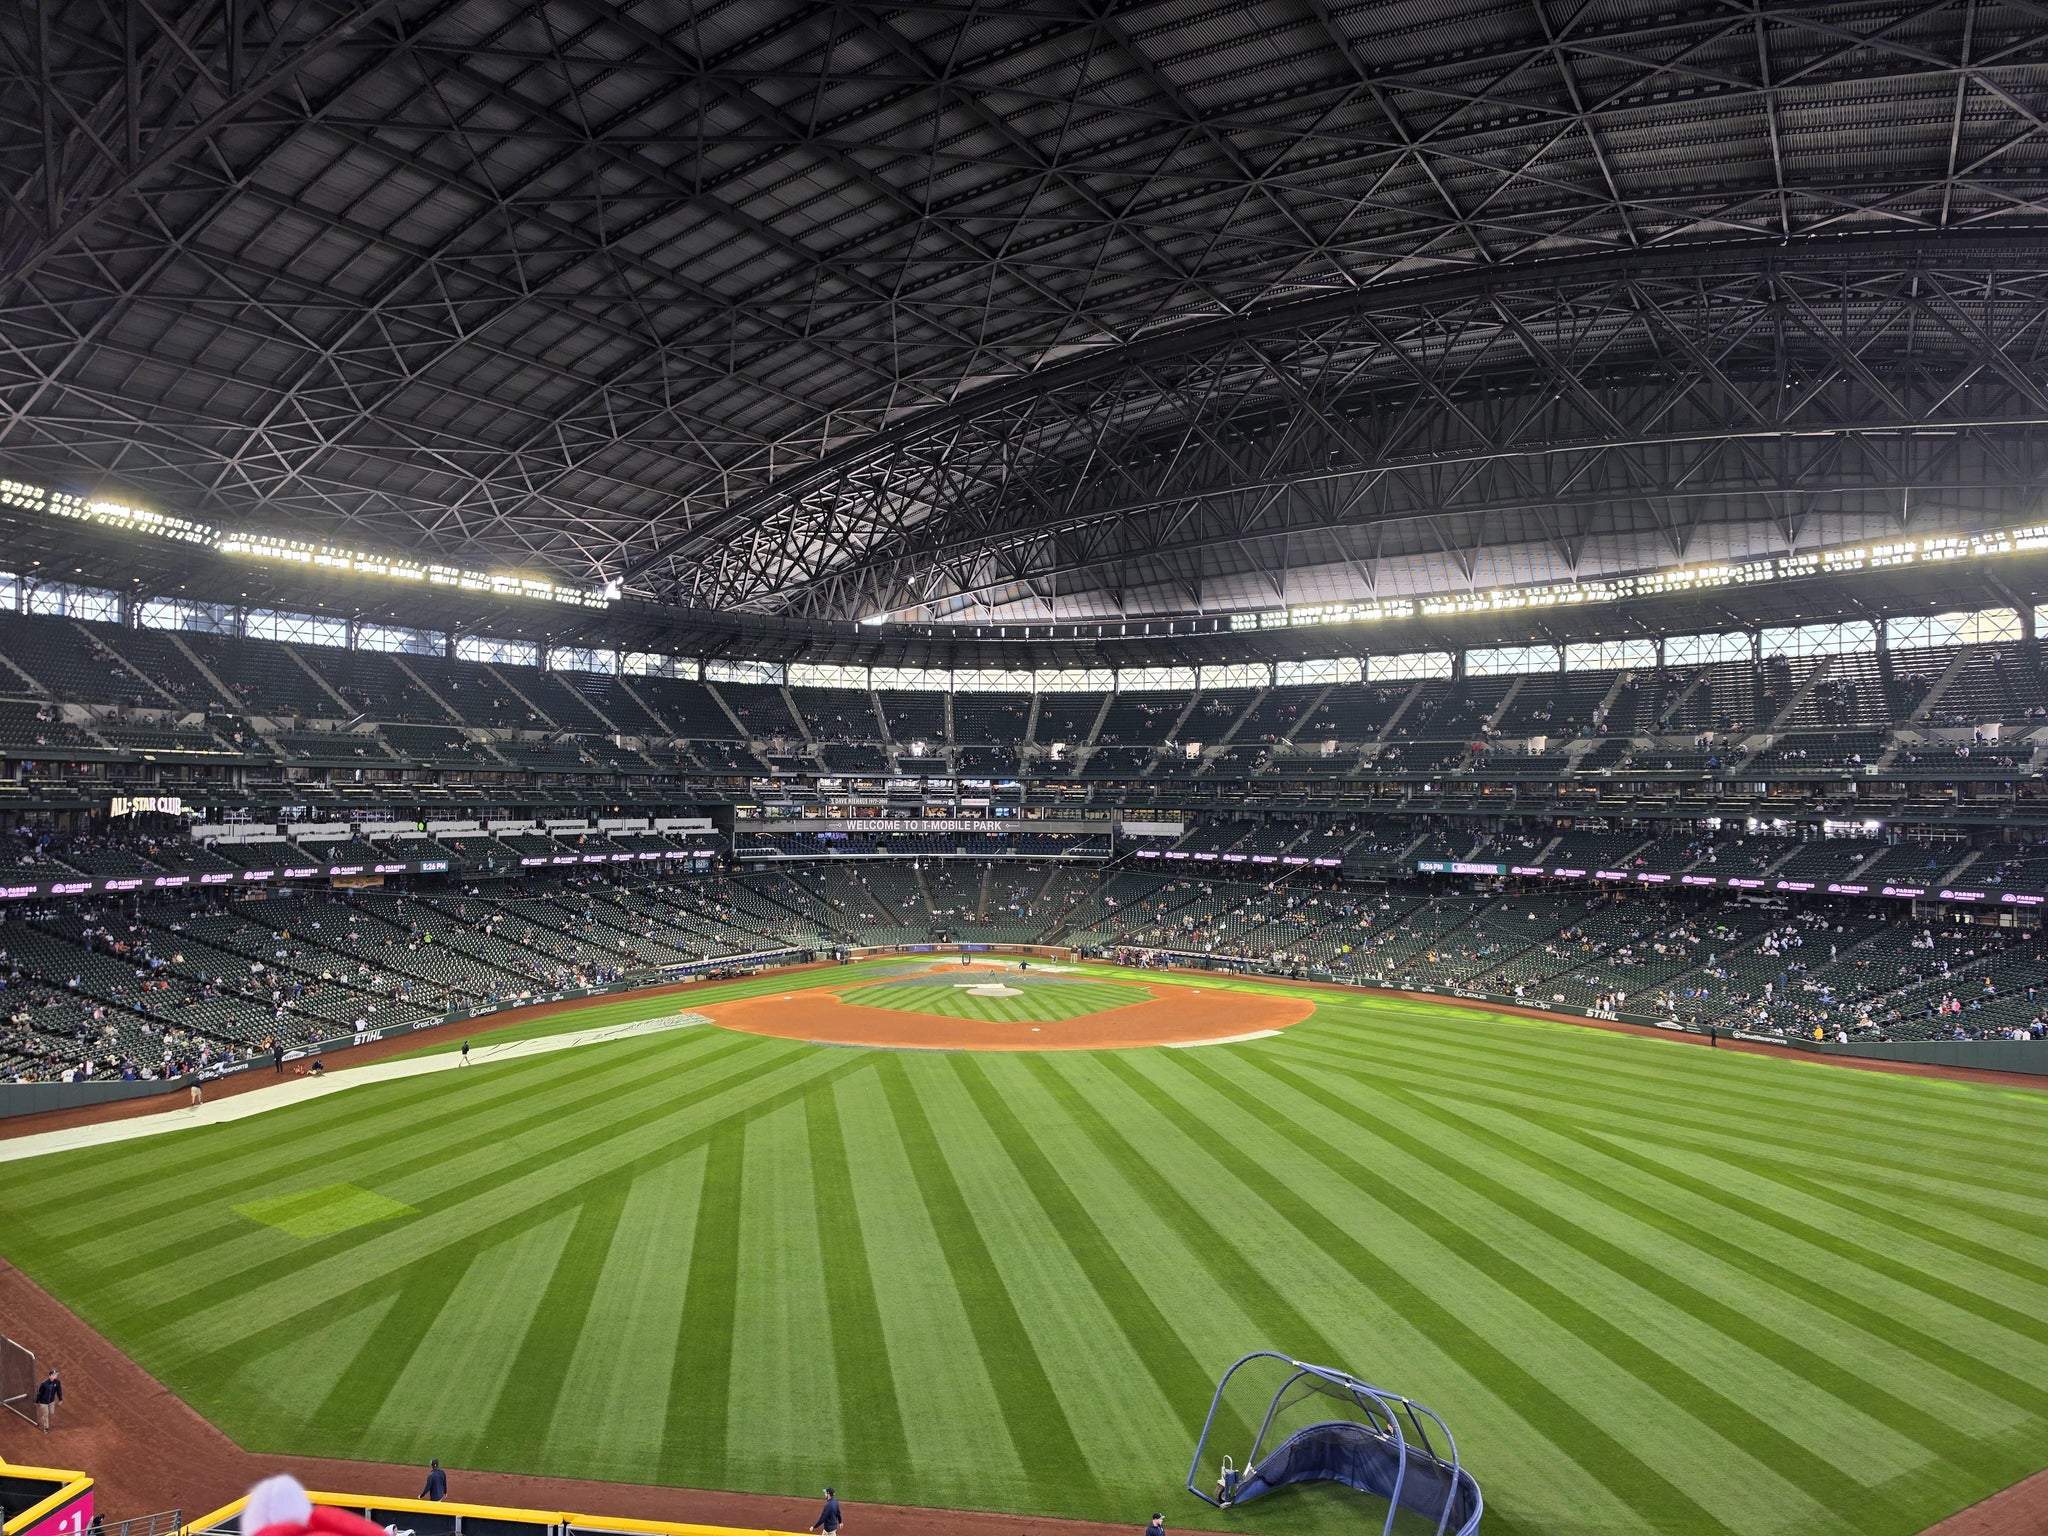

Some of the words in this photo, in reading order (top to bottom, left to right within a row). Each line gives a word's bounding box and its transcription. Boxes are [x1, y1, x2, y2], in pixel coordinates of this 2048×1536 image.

[157, 797, 181, 815] CLUB
[847, 820, 900, 830] WELCOME
[904, 820, 919, 830] TO
[922, 820, 971, 830] T-MOBILE
[973, 820, 1002, 830] PARK
[1466, 864, 1498, 874] BALLPARK
[1463, 992, 1487, 1000] LEXUS
[477, 1005, 497, 1015] LEXUS
[1515, 998, 1534, 1007] Great
[1534, 1001, 1551, 1010] Clips
[1586, 1008, 1619, 1021] STIHL
[413, 1020, 430, 1030] Great
[430, 1016, 444, 1027] Clips
[353, 1030, 383, 1046] STIHL
